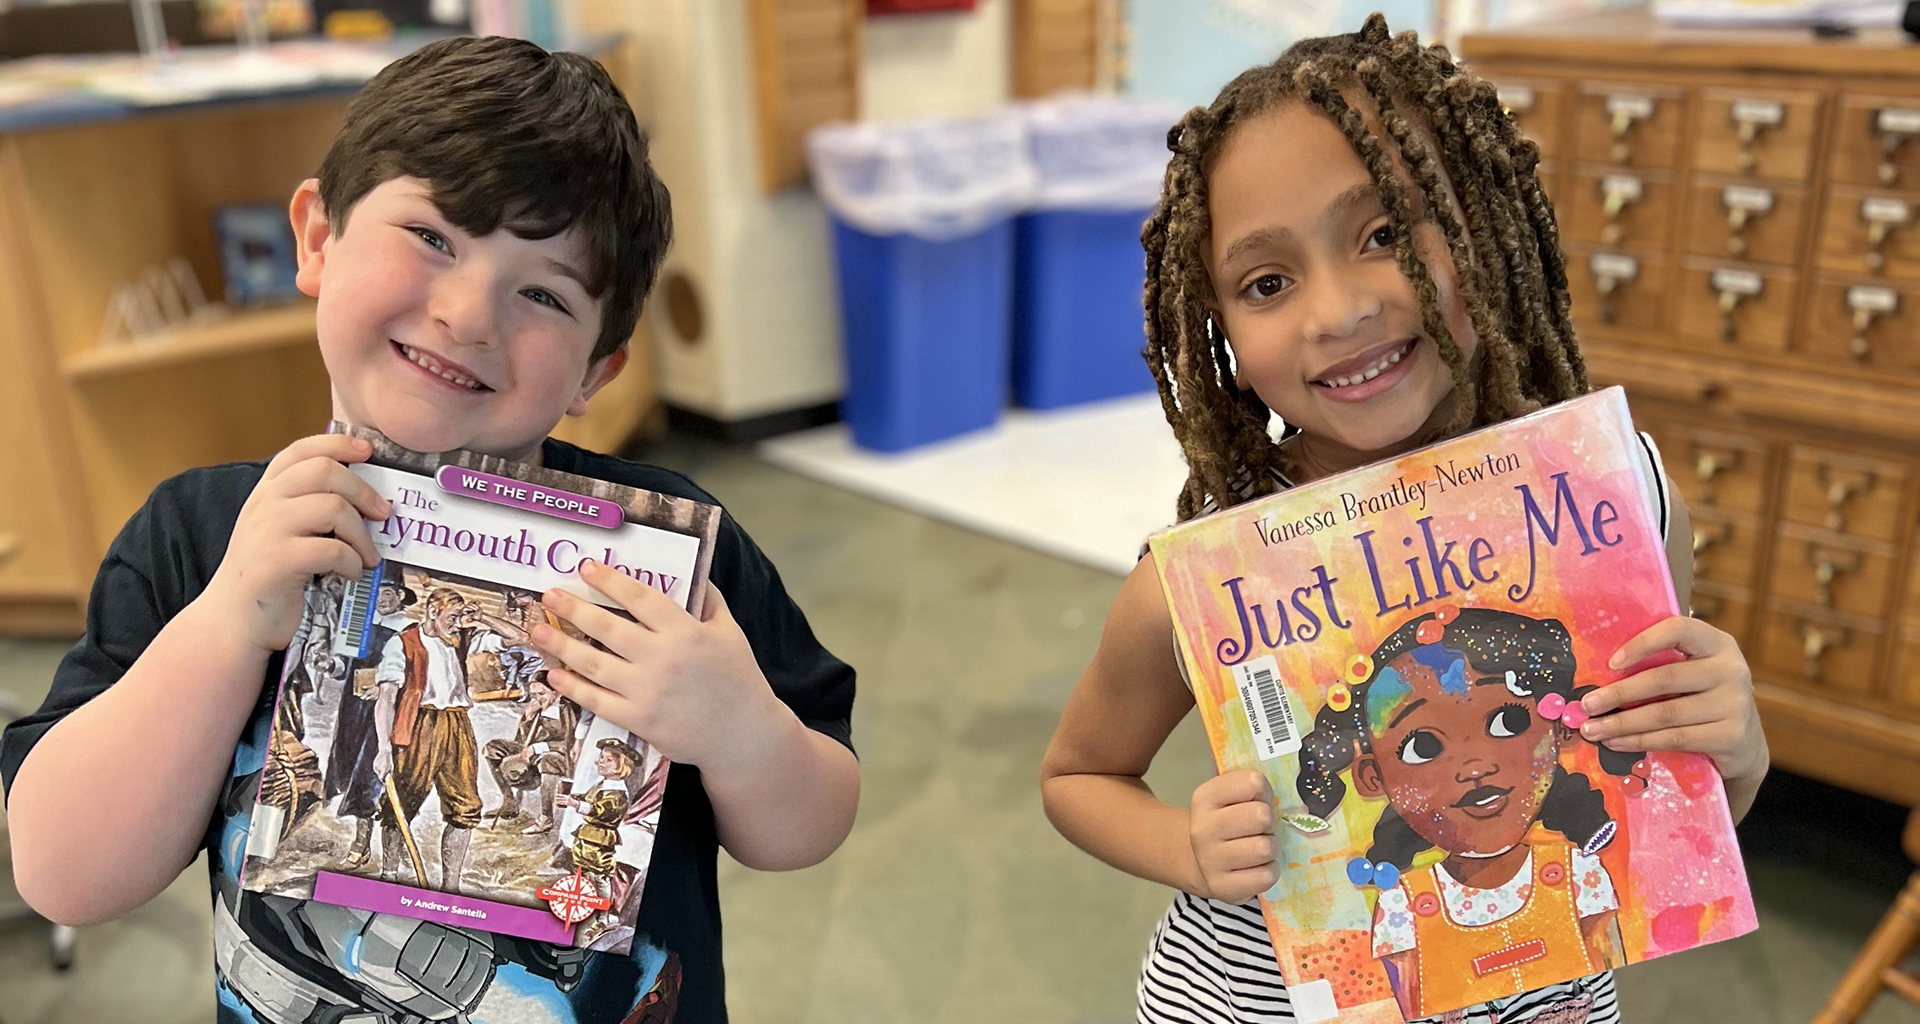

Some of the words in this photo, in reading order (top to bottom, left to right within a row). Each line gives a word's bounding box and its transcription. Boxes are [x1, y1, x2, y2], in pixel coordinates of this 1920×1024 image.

[398, 487, 439, 511] The
[462, 474, 488, 492] WE
[494, 483, 527, 500] THE
[532, 491, 599, 517] PEOPLE
[1253, 510, 1337, 547] Vanessa
[1340, 452, 1521, 522] Brantley-Newton
[379, 499, 537, 567] lymouth
[1216, 565, 1352, 666] Just
[1353, 515, 1500, 617] Like
[1507, 471, 1624, 603] Me
[1280, 695, 1294, 725] ELEMENTARY
[400, 896, 413, 907] by
[414, 899, 450, 912] Andrew
[451, 905, 487, 919] Santella
[542, 888, 578, 900] COMPASS
[580, 896, 604, 905] POINT
